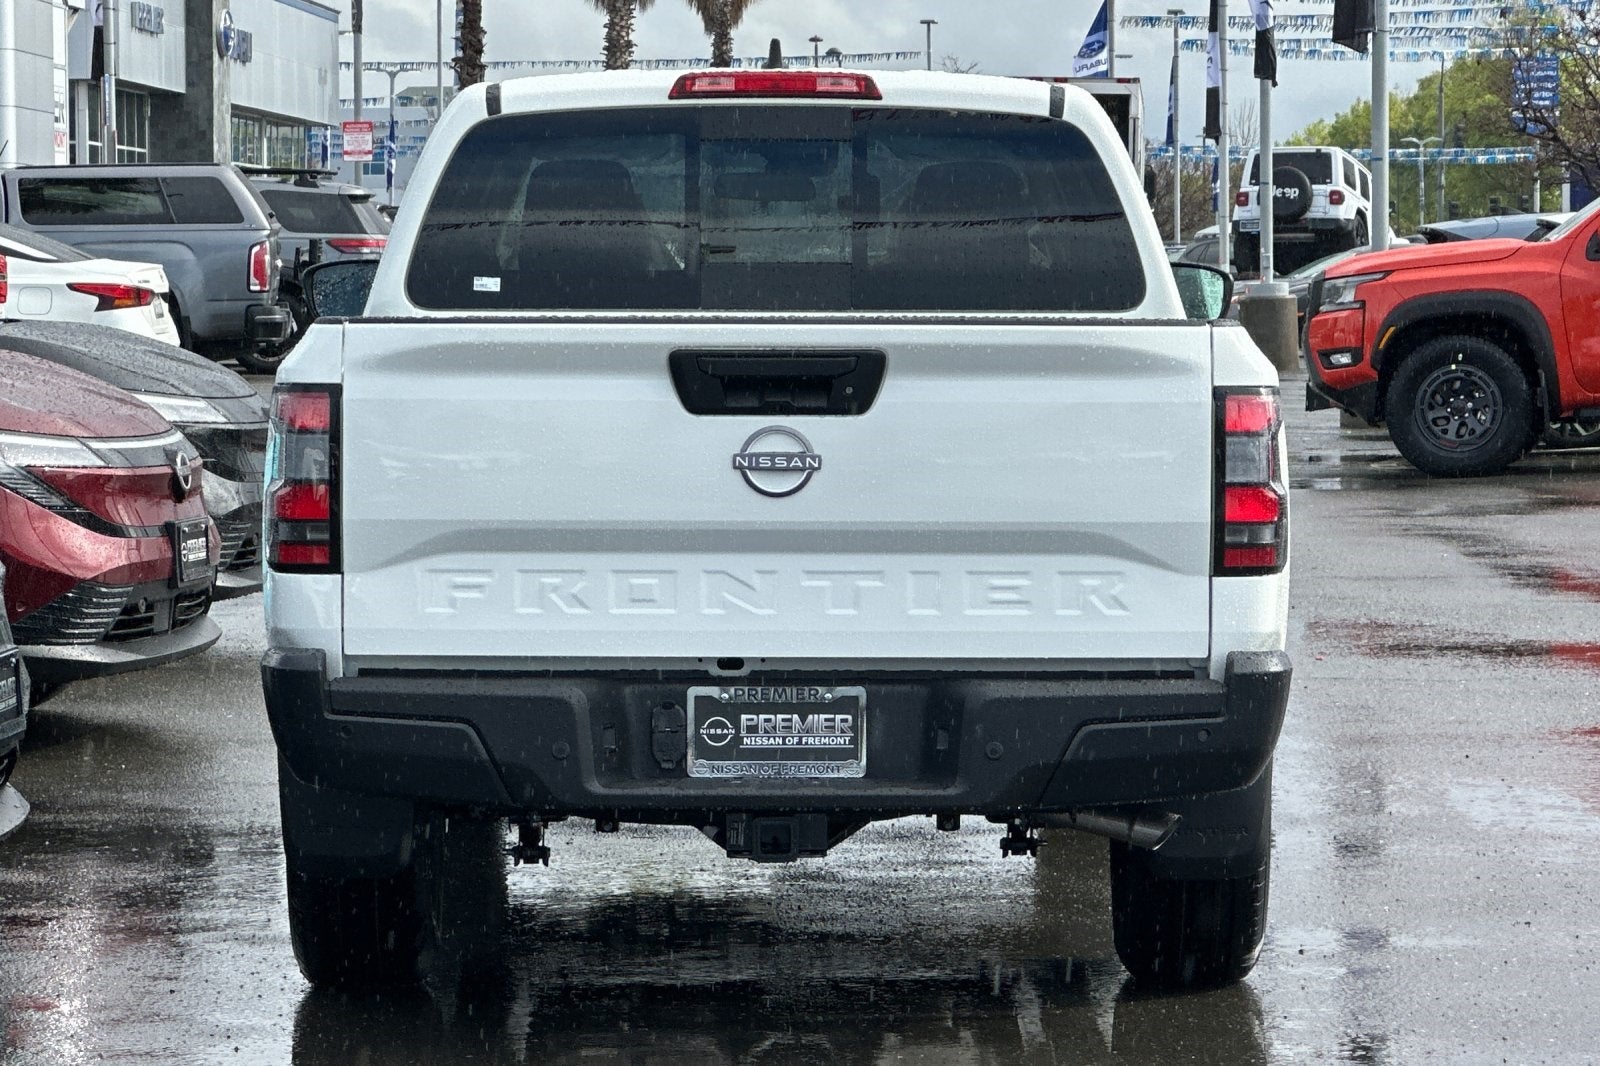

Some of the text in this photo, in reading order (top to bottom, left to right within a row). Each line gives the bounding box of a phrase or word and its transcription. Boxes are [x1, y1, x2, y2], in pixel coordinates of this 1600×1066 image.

[735, 456, 819, 468] NISSAN
[419, 569, 1131, 616] FRONTIER
[733, 687, 820, 701] PREMIER
[740, 714, 853, 734] PREMIER
[743, 736, 851, 745] NISSAN OF FREMONT
[711, 763, 842, 775] NISSAN OF FREMONT
